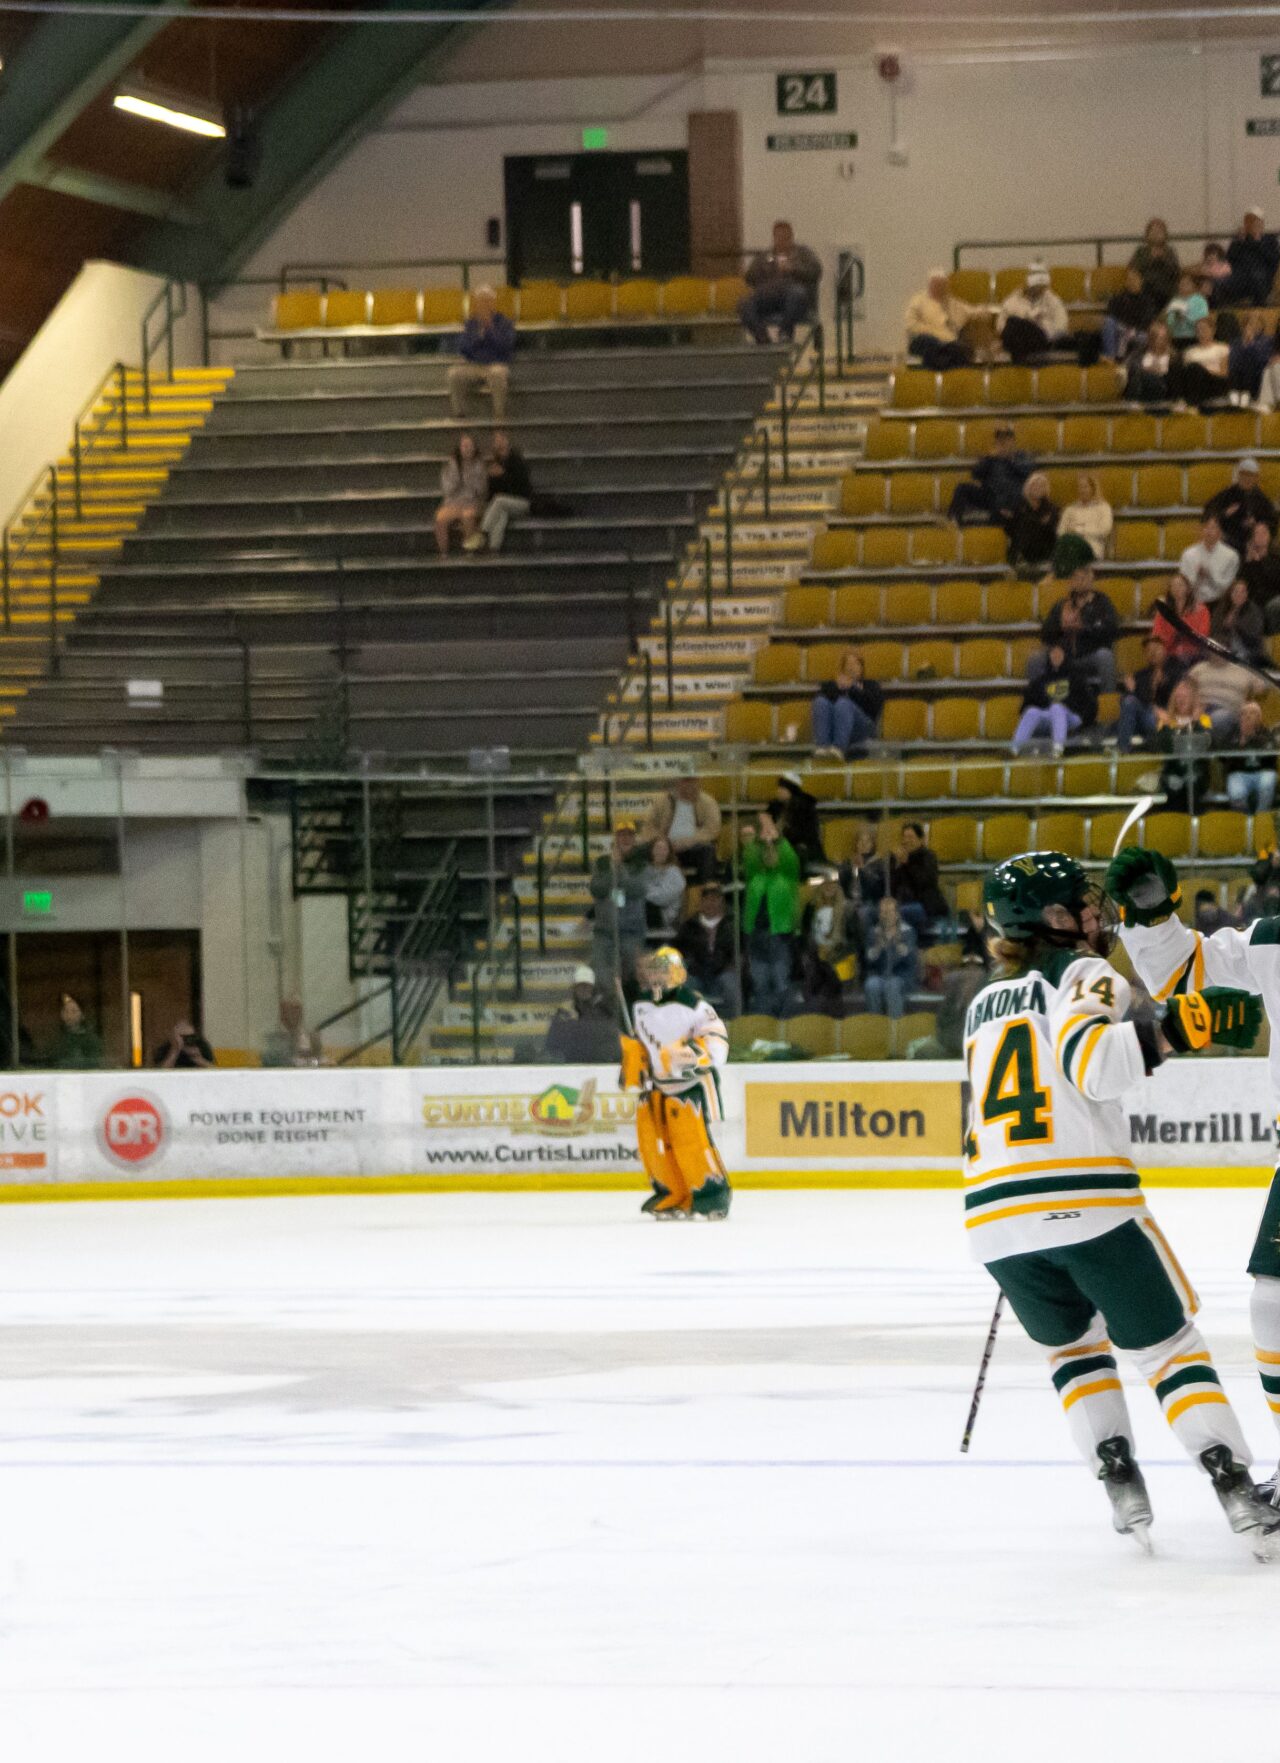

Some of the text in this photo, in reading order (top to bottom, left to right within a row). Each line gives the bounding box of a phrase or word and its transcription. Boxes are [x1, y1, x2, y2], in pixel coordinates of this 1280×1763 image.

[784, 77, 829, 109] 24
[1072, 976, 1115, 1007] 14
[0, 1093, 43, 1117] OK
[190, 1110, 366, 1126] POWER EQUIPMENT
[423, 1101, 526, 1122] CURTIS
[780, 1100, 926, 1138] Milton
[110, 1113, 157, 1144] DR
[218, 1129, 329, 1144] DONE RIGHT
[1129, 1112, 1243, 1144] Merrill
